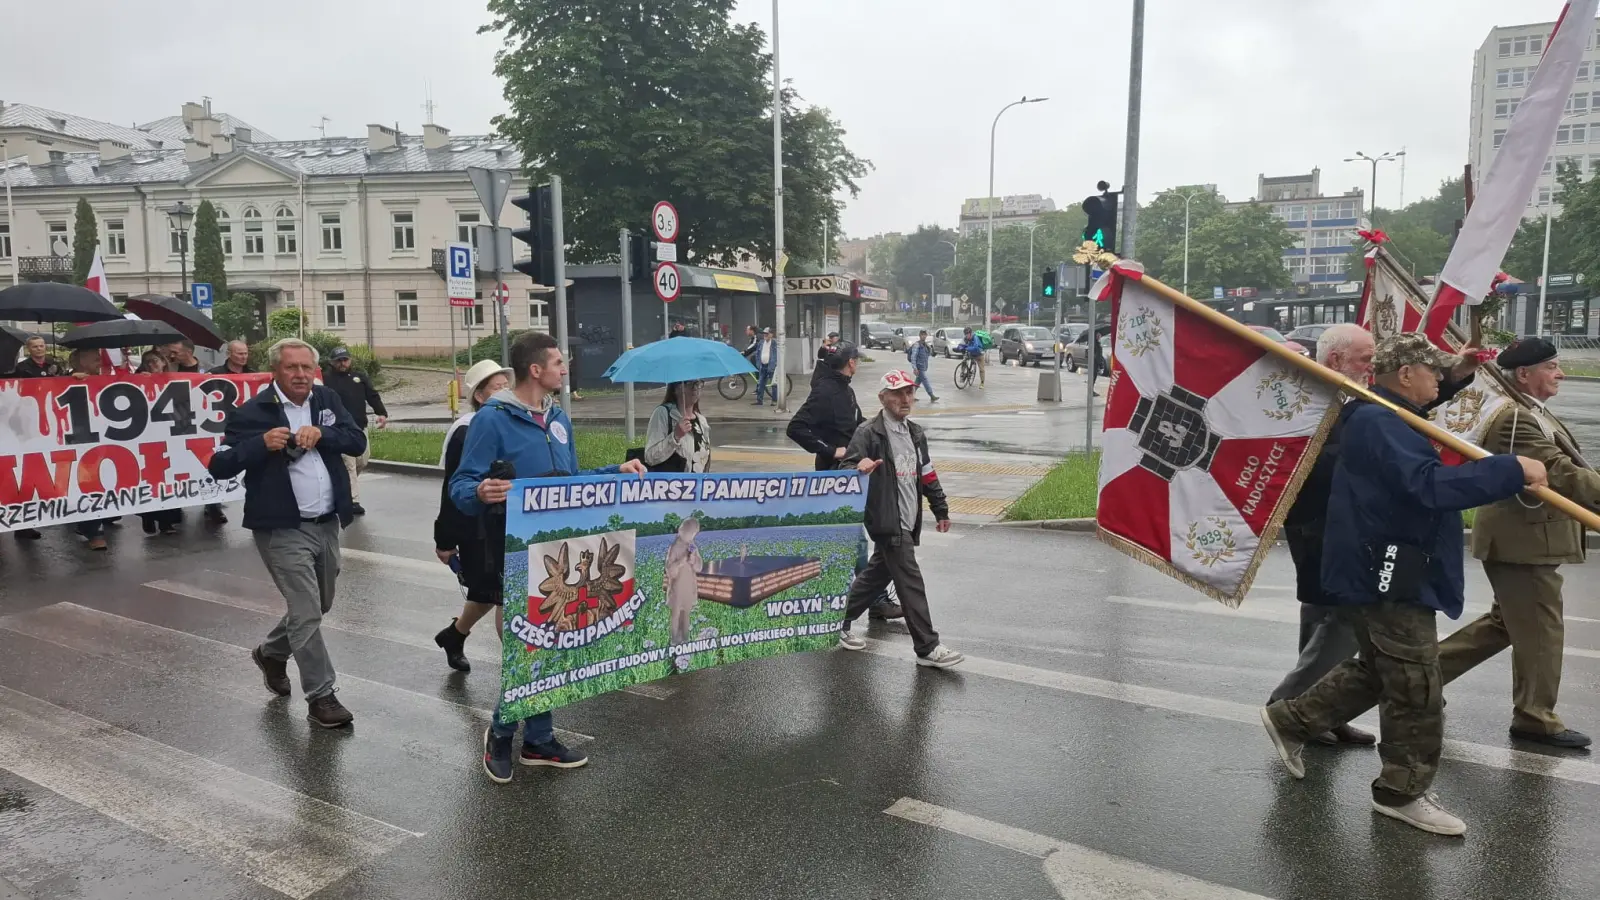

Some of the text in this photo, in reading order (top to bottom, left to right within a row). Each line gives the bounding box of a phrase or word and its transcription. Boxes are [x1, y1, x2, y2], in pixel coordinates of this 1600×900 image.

[455, 250, 467, 275] P
[196, 286, 208, 305] P
[659, 272, 677, 291] 40
[784, 278, 832, 291] SERO
[56, 379, 240, 445] 1943
[1235, 455, 1260, 488] KOŁO
[1242, 442, 1287, 515] RADOSZYCE
[523, 475, 862, 512] KIELECKI MARSZ PAMIĘCI 11 LIPCA
[1196, 529, 1222, 546] 1939
[510, 588, 647, 649] CZEŚĆ ICH PAMIĘCI
[767, 593, 822, 617] WOŁYŃ
[504, 671, 568, 703] SPOŁECZNY
[570, 658, 618, 683] KOMITET
[618, 647, 667, 672] BUDOWY
[668, 637, 718, 658] POMNIKA
[720, 626, 795, 648] WOŁYŃSKIEGO
[797, 625, 809, 636] W
